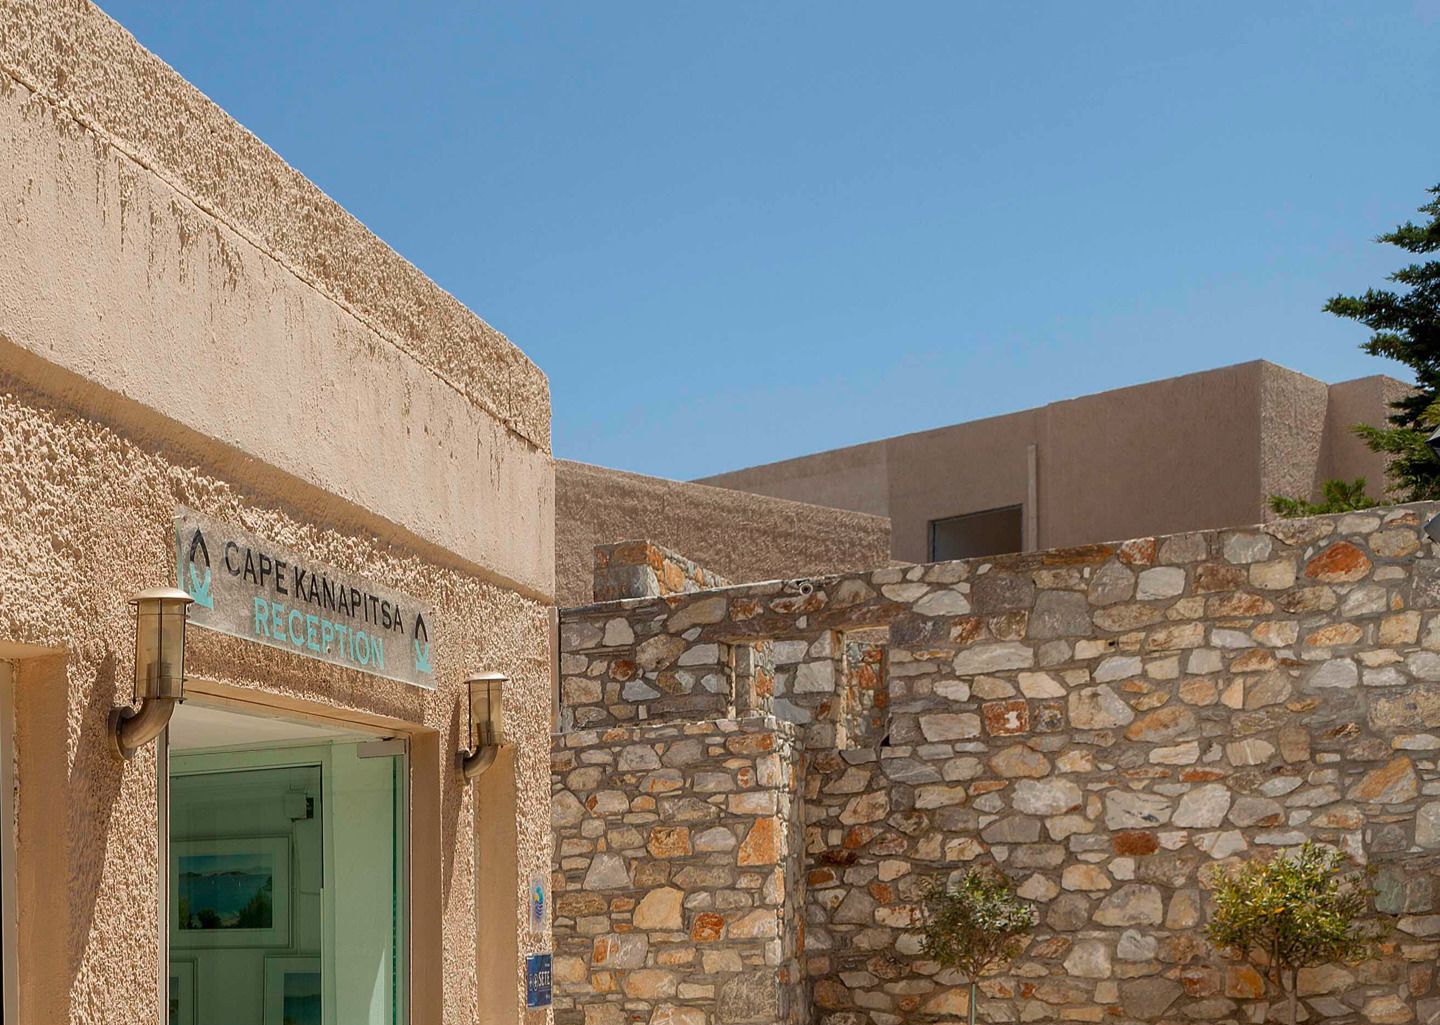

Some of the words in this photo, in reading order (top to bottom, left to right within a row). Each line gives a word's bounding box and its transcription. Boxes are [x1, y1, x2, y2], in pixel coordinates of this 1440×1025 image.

[225, 541, 288, 595] CAPE
[294, 566, 404, 634] KANAPITSA
[254, 597, 384, 670] RECEPTION
